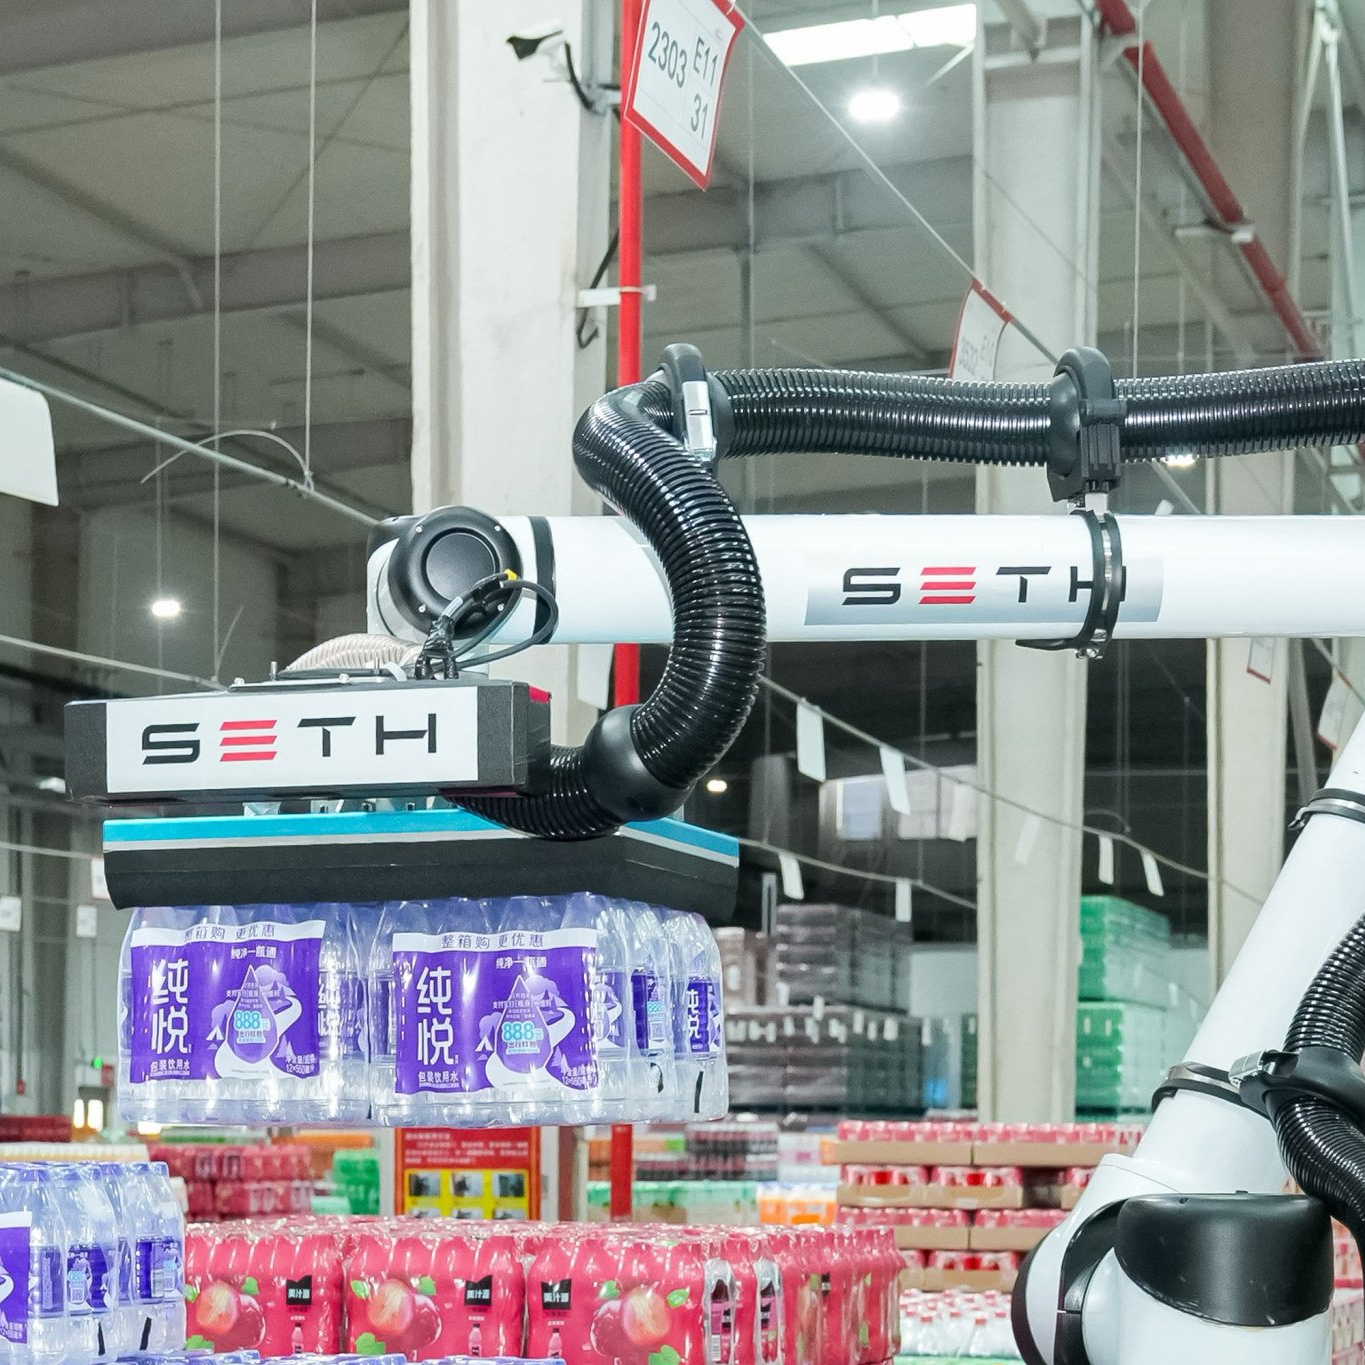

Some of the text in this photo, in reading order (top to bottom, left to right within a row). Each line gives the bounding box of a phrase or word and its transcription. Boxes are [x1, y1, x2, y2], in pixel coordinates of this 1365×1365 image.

[648, 21, 687, 89] 2303
[693, 36, 718, 88] E11
[691, 93, 709, 139] 31
[141, 713, 437, 765] SETH
[234, 924, 275, 940] 更优惠
[499, 933, 543, 948] 更优惠
[152, 958, 188, 1054] 纯悦
[417, 966, 454, 1066] 纯悦
